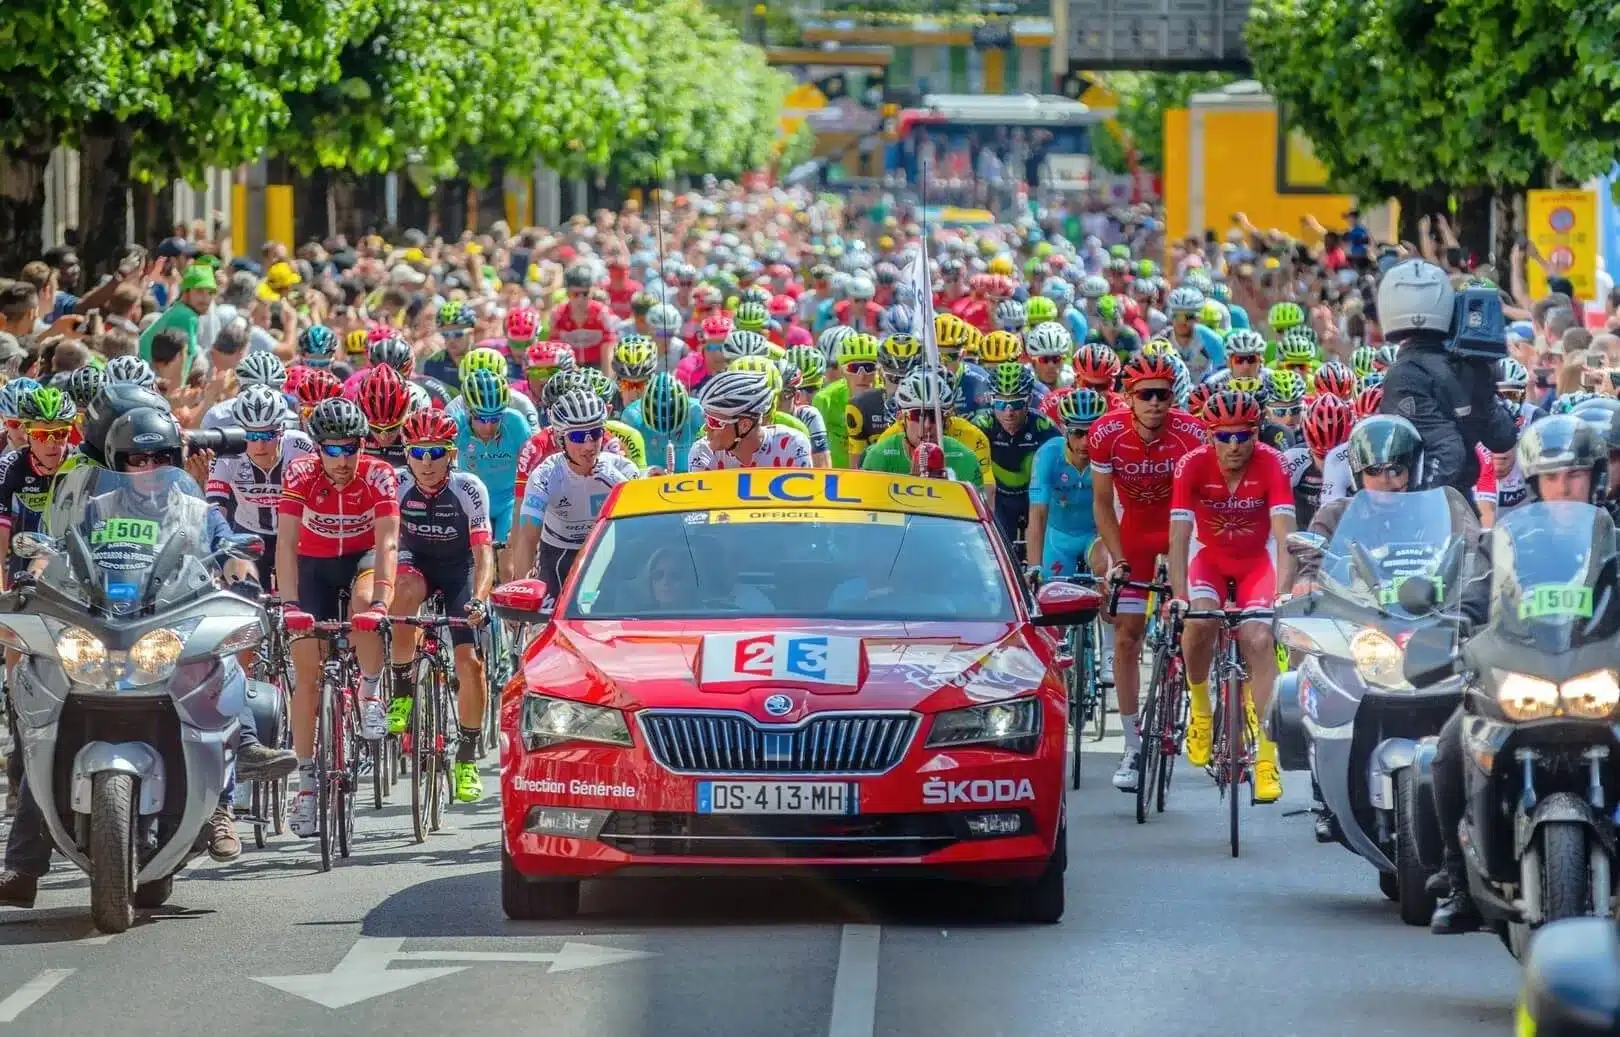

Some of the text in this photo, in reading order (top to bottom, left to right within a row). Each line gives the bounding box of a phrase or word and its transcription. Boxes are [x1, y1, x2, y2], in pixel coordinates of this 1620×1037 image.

[610, 428, 642, 460] inkoff
[1089, 419, 1125, 450] Cofidis
[1111, 458, 1174, 475] Cofidi
[461, 480, 484, 511] BORA
[663, 479, 713, 494] LCL
[736, 471, 863, 503] LCL
[892, 483, 943, 499] LCL
[1199, 495, 1265, 510] Cofidis
[314, 514, 369, 525] LOTTO
[749, 510, 825, 520] OFFICIEL
[117, 521, 154, 540] 504
[406, 521, 458, 535] BORA
[565, 523, 594, 532] etix
[1547, 588, 1587, 609] 507
[513, 775, 636, 798] Direction Générale
[922, 776, 1036, 804] ŠKODA
[713, 784, 843, 811] DS-413-MH
